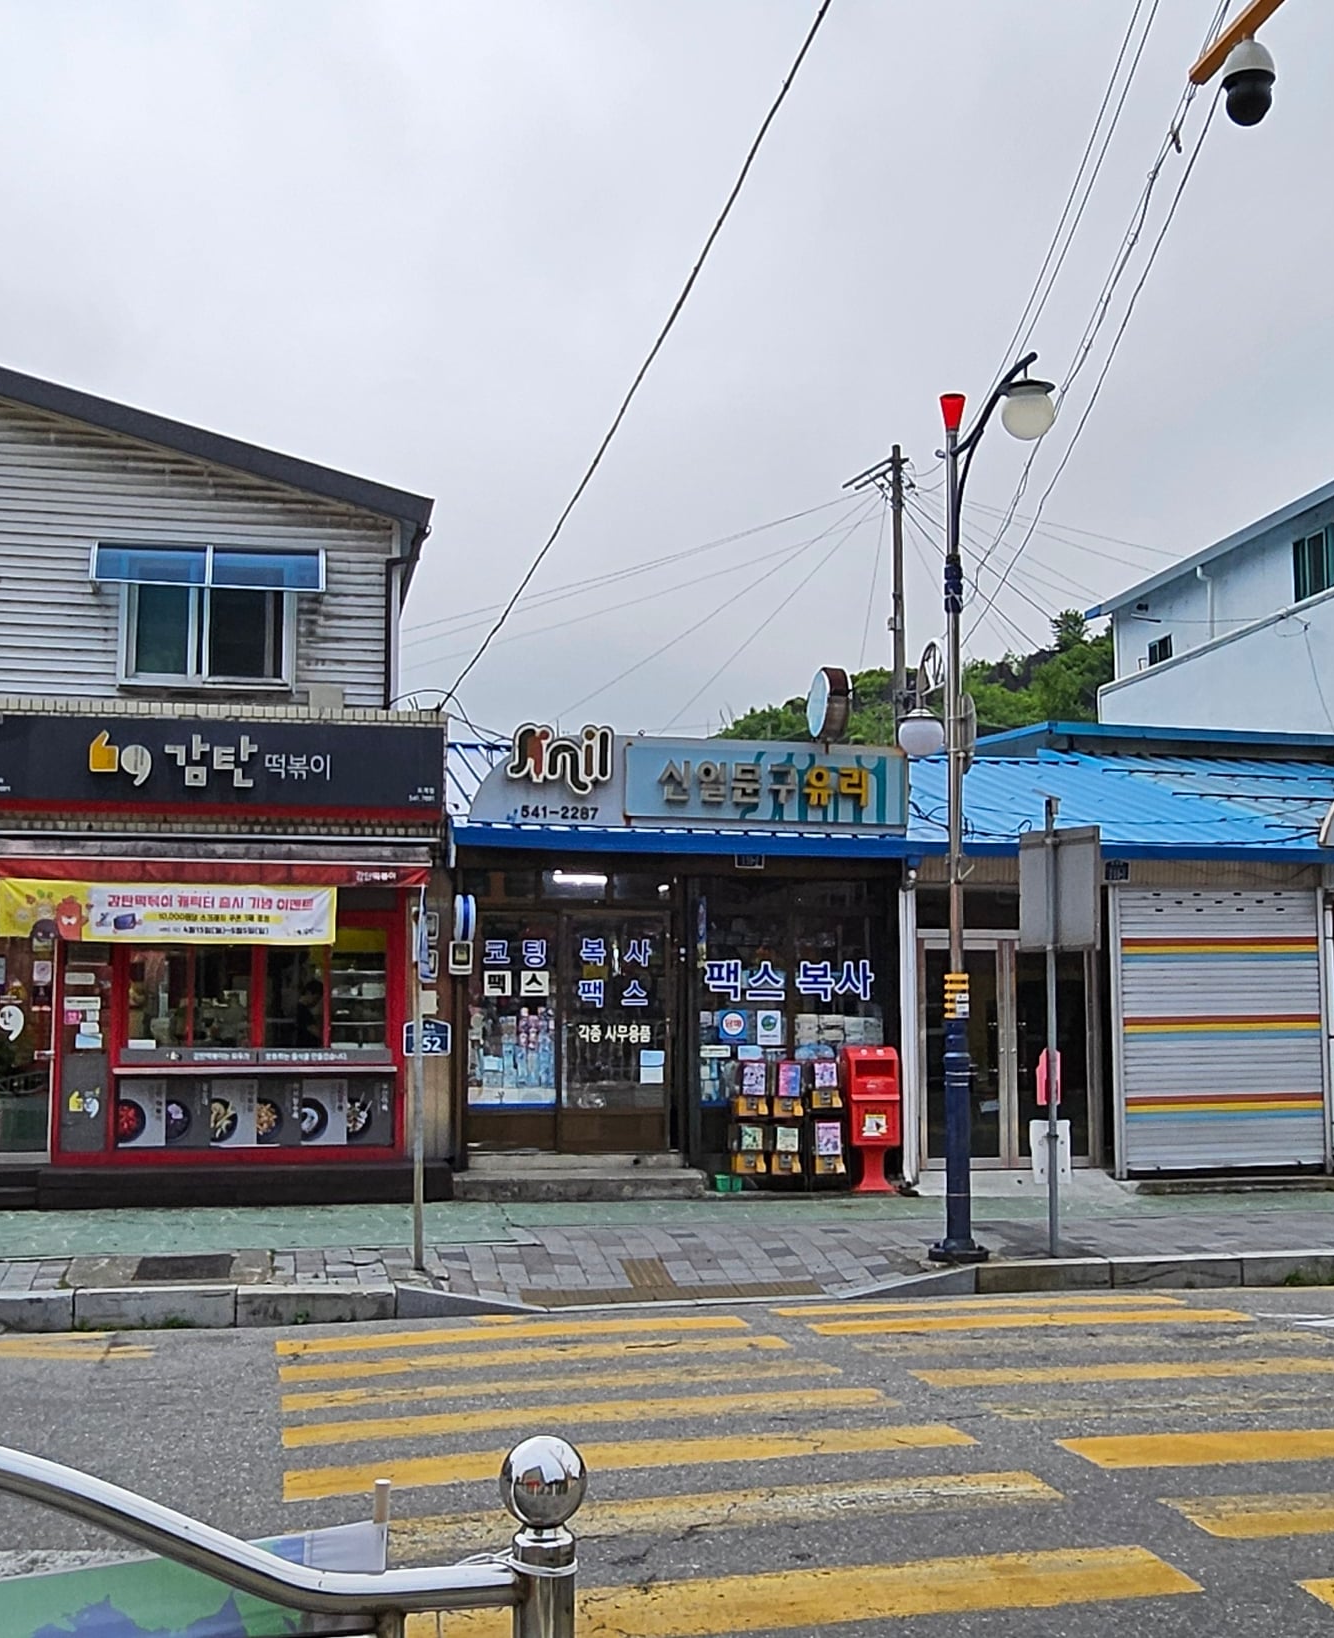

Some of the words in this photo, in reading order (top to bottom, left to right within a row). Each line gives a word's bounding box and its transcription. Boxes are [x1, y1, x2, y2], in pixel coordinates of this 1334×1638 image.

[164, 734, 258, 788] 감탄
[264, 753, 332, 781] 떡볶이
[520, 805, 599, 820] 541-2287
[108, 894, 173, 908] 감탄떡볶이
[177, 894, 215, 909] 캐릭터
[276, 897, 314, 911] 이벤트
[483, 939, 547, 967] 코팅
[579, 937, 651, 967] 복사
[487, 973, 547, 995] 팩스
[578, 978, 650, 1008] 팩스
[705, 959, 786, 1001] 팩스
[796, 959, 875, 1001] 복사
[578, 1024, 602, 1043] 각종
[605, 1024, 652, 1044] 사무용품
